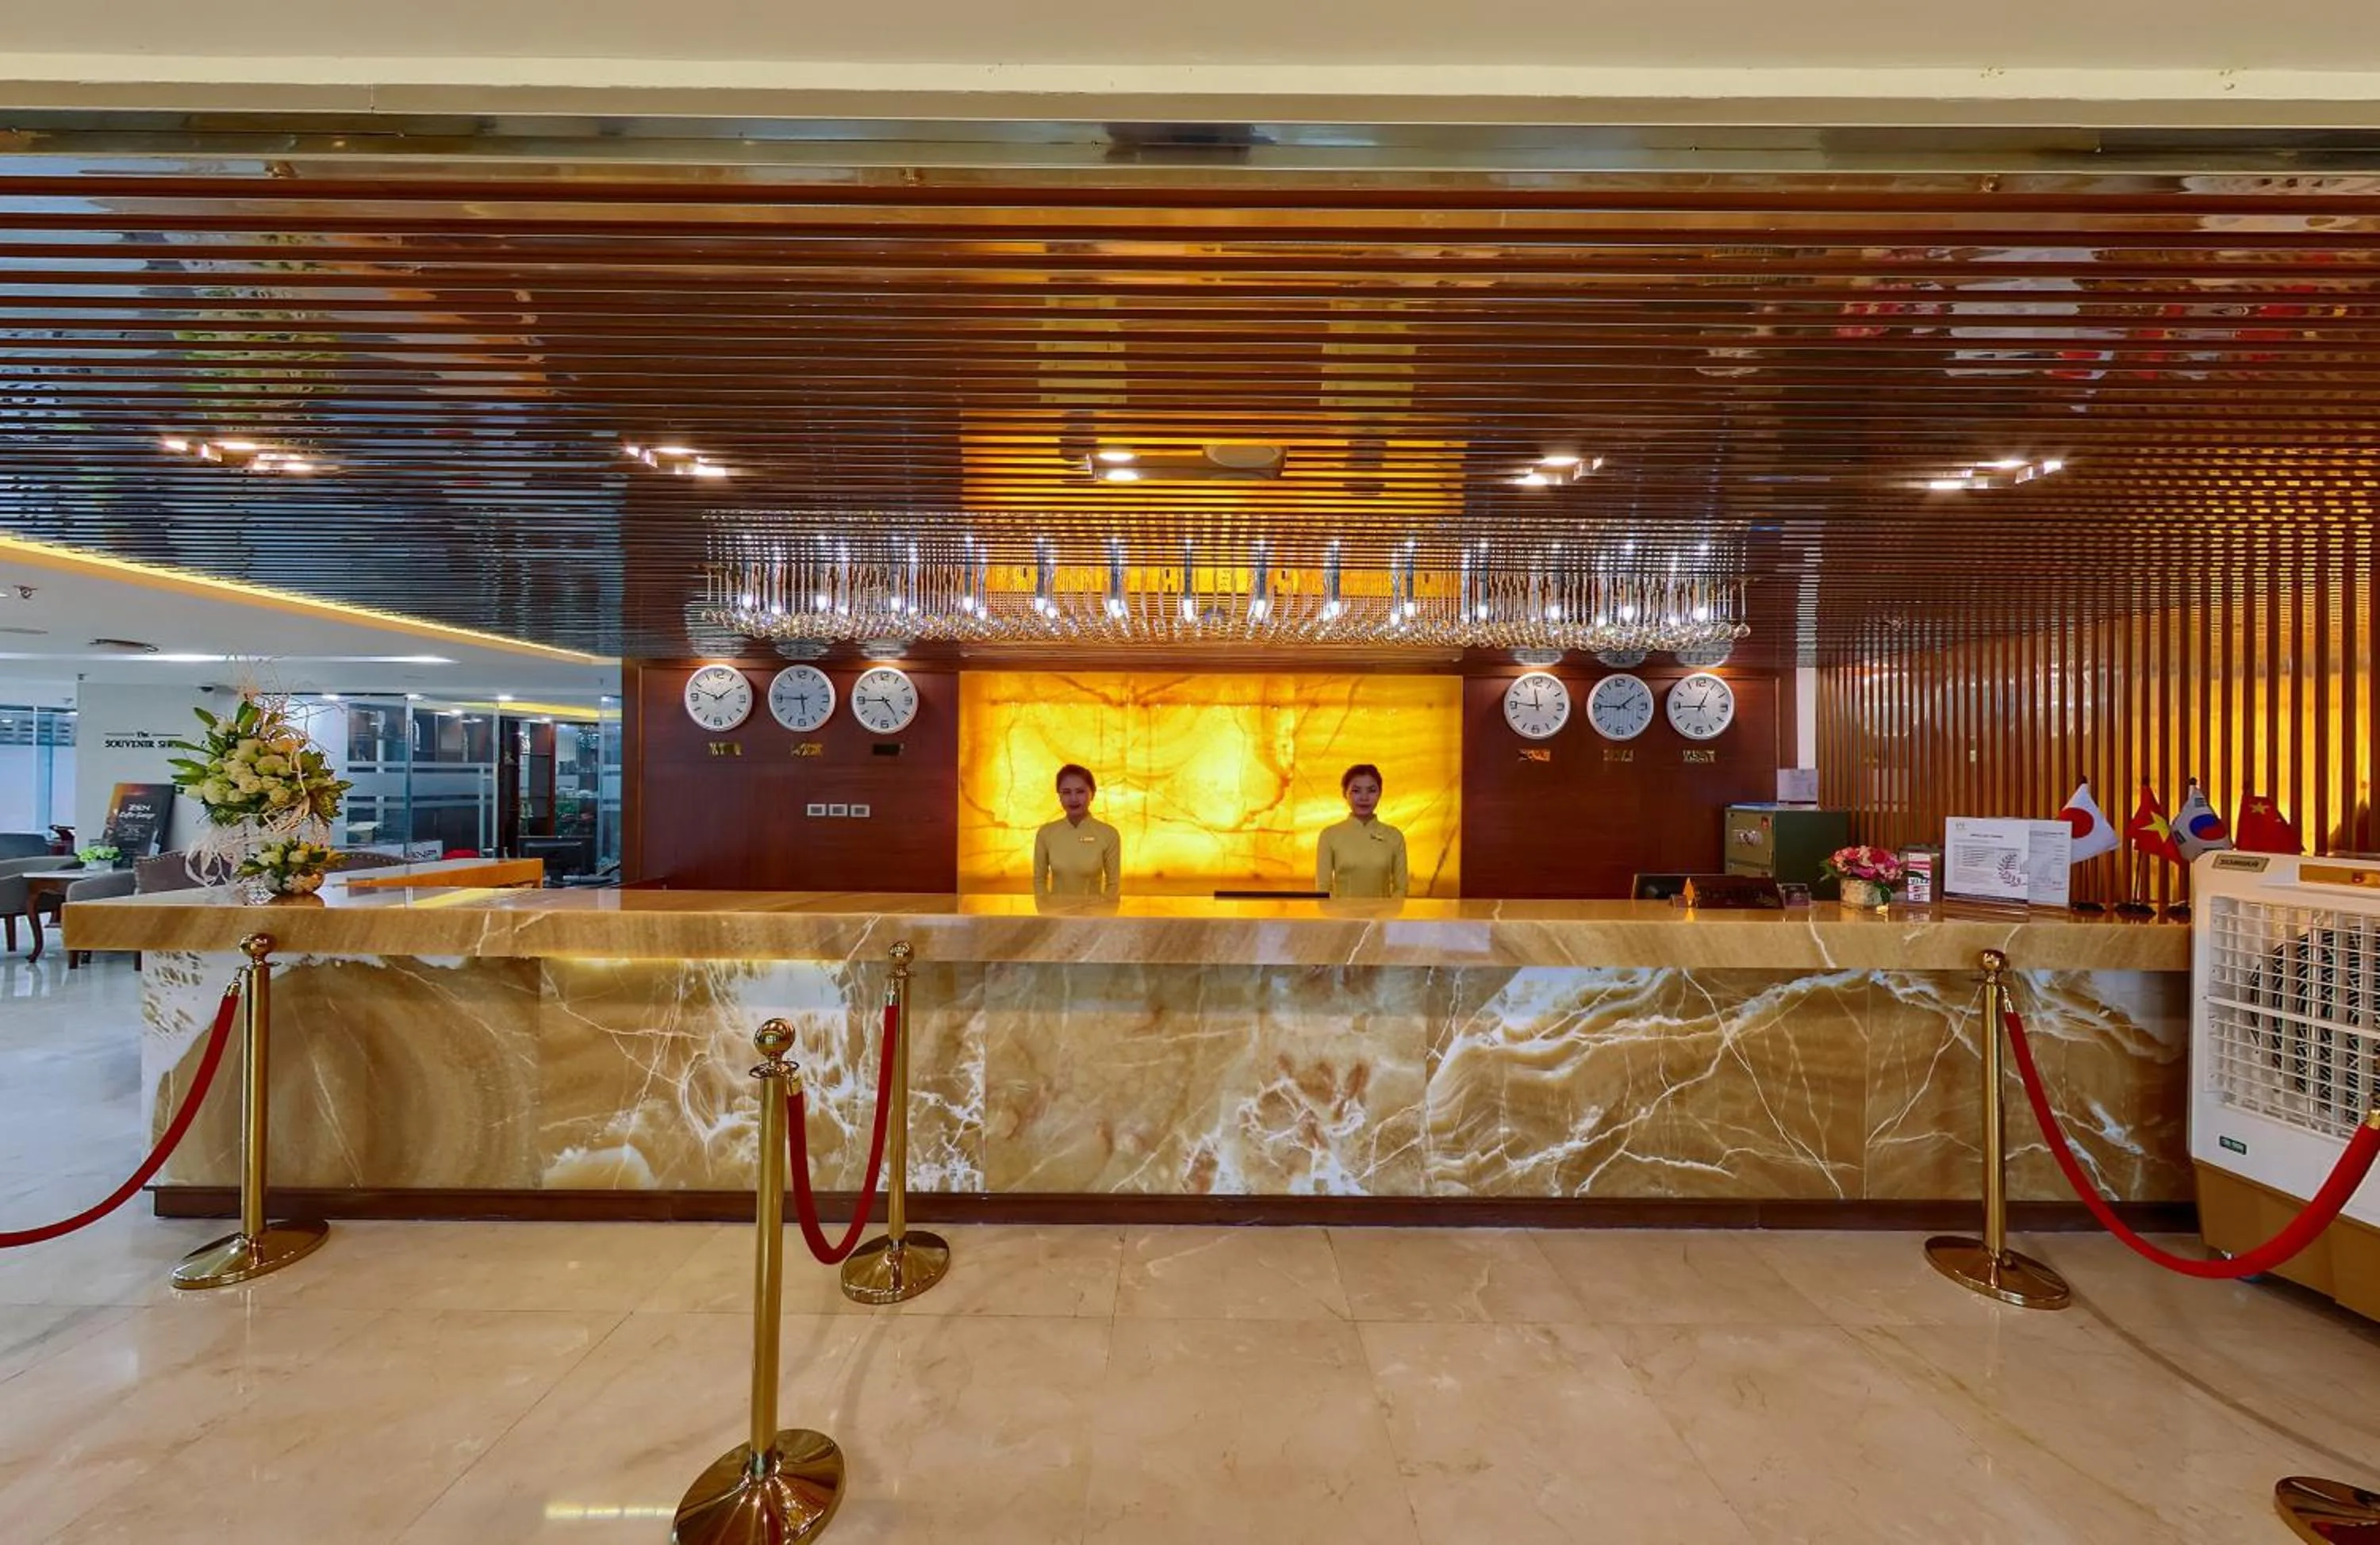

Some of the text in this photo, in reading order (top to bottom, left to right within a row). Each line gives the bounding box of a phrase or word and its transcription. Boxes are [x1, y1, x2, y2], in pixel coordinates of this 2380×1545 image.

[1614, 678, 1626, 687] 12
[1695, 678, 1706, 687] 12
[797, 718, 807, 726] 6
[880, 719, 889, 728] 6
[1694, 726, 1703, 734] 6
